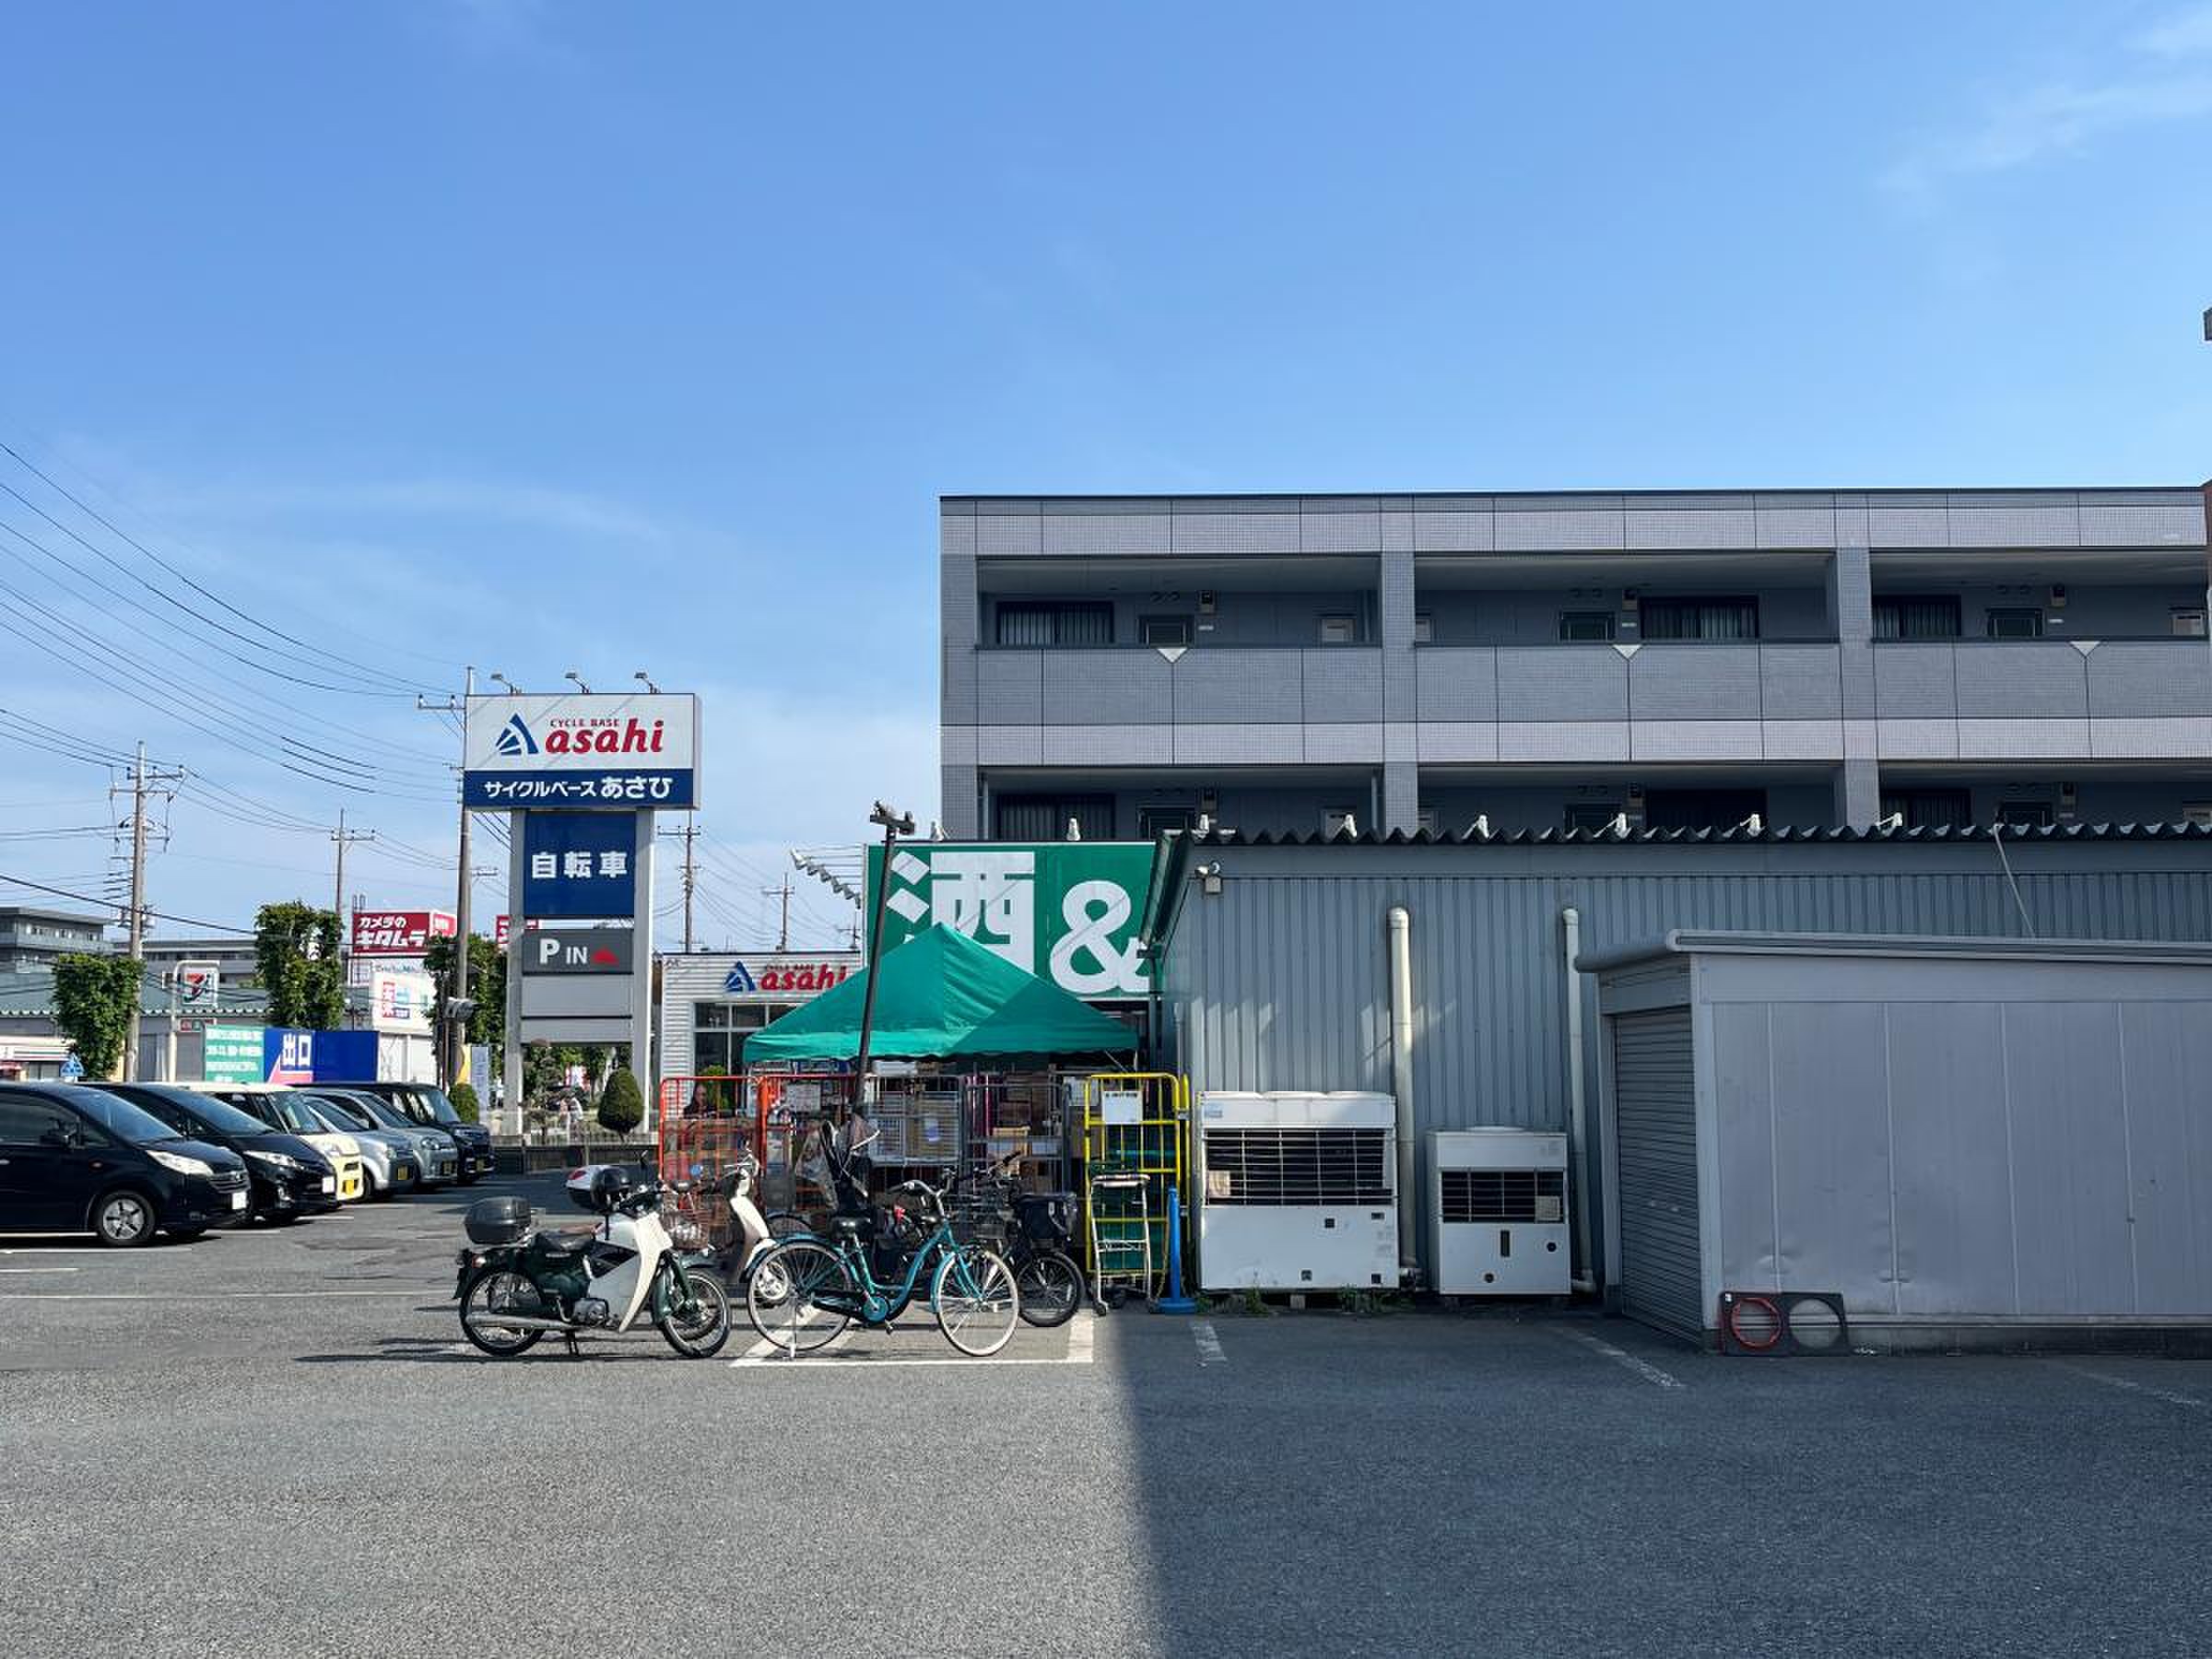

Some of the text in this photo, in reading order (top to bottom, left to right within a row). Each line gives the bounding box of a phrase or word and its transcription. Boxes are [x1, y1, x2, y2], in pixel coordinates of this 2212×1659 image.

[545, 718, 665, 754] asahi
[550, 719, 620, 727] CYCLE BASE
[532, 852, 628, 878] 自転車
[359, 916, 406, 928] カメラの
[356, 930, 426, 947] キタムラ
[539, 938, 588, 965] P IN
[282, 1032, 312, 1066] 出口
